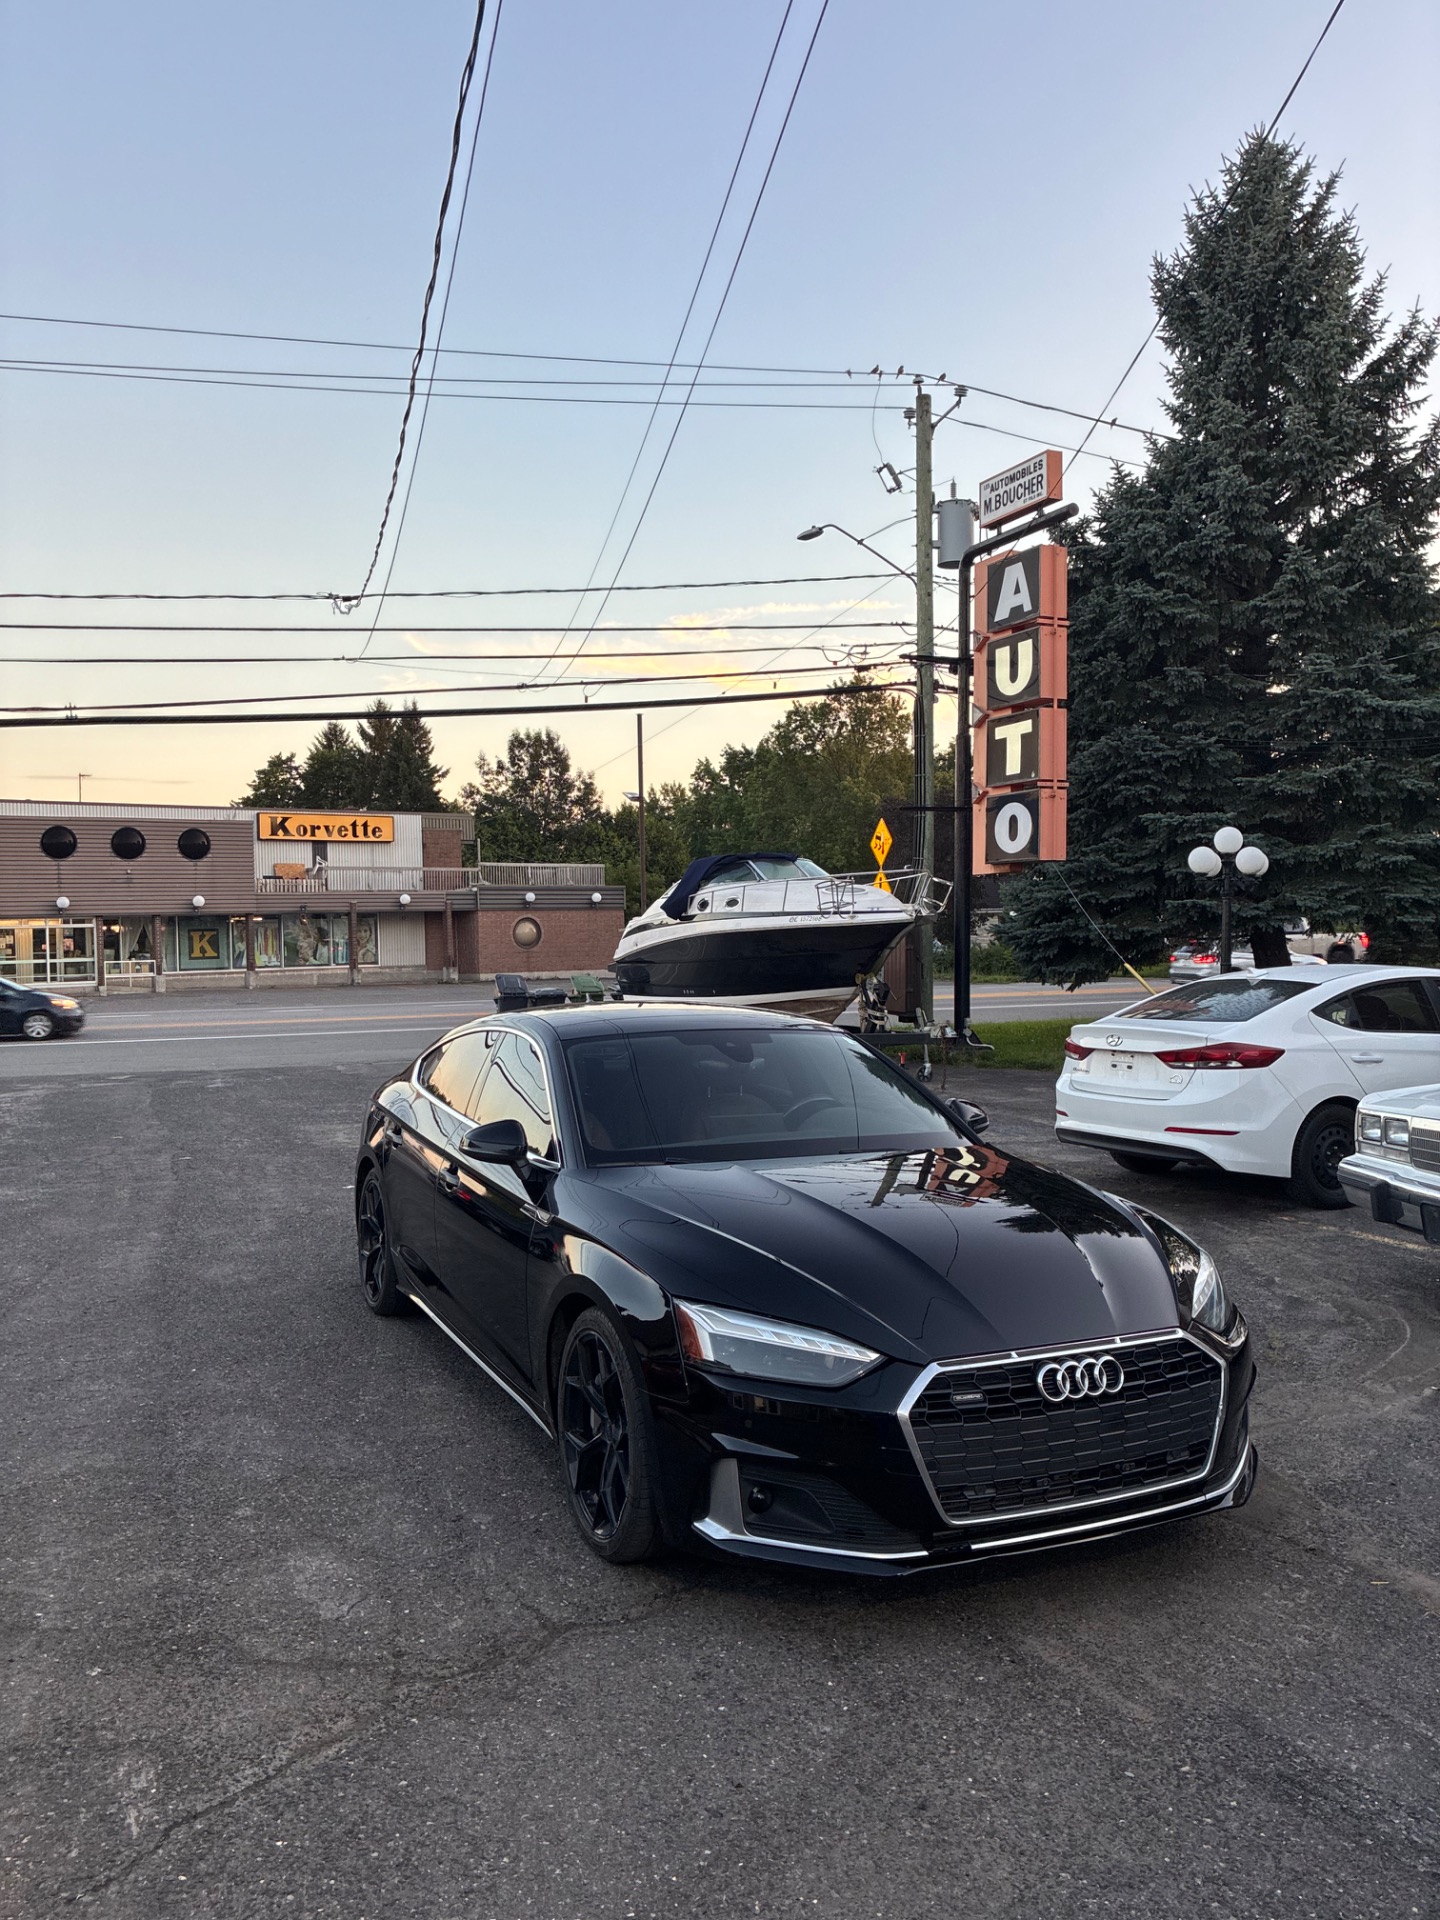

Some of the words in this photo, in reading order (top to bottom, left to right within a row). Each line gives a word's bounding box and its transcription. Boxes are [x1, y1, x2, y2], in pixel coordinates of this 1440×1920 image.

[990, 459, 1043, 494] AUTOMOBILES
[994, 561, 1033, 854] AUTO
[268, 816, 383, 839] Korvette
[190, 930, 218, 958] K
